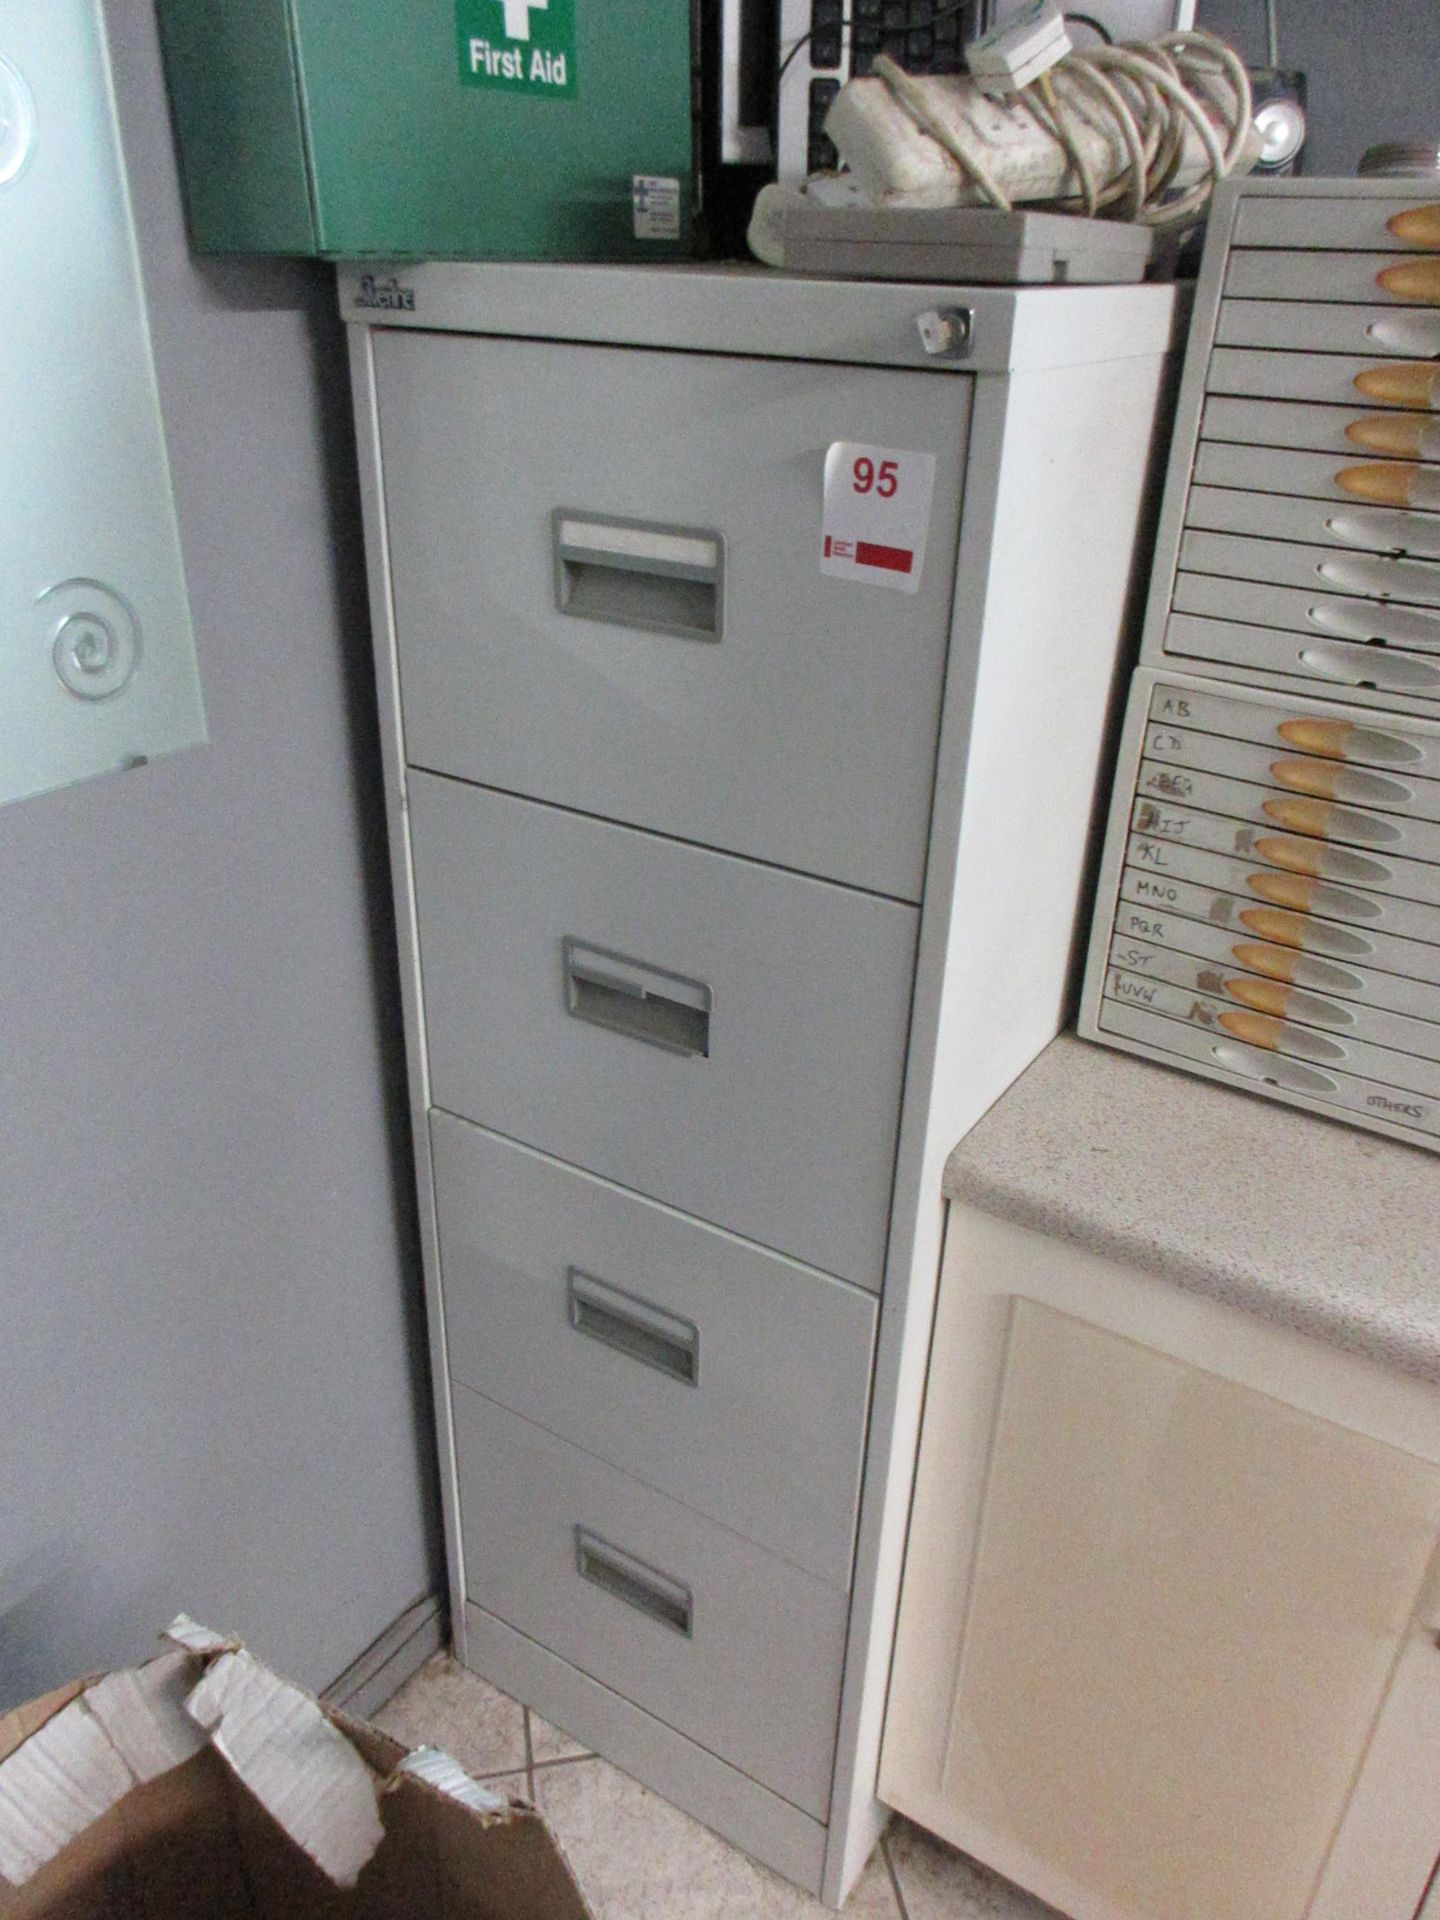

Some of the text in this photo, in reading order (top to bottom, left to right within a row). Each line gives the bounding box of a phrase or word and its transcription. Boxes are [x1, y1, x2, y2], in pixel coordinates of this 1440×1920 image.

[469, 38, 567, 86] First Aid
[853, 457, 898, 497] 95
[1136, 880, 1178, 902] MNO
[1130, 916, 1164, 938] PQR
[1366, 1096, 1424, 1119] OTHERS
